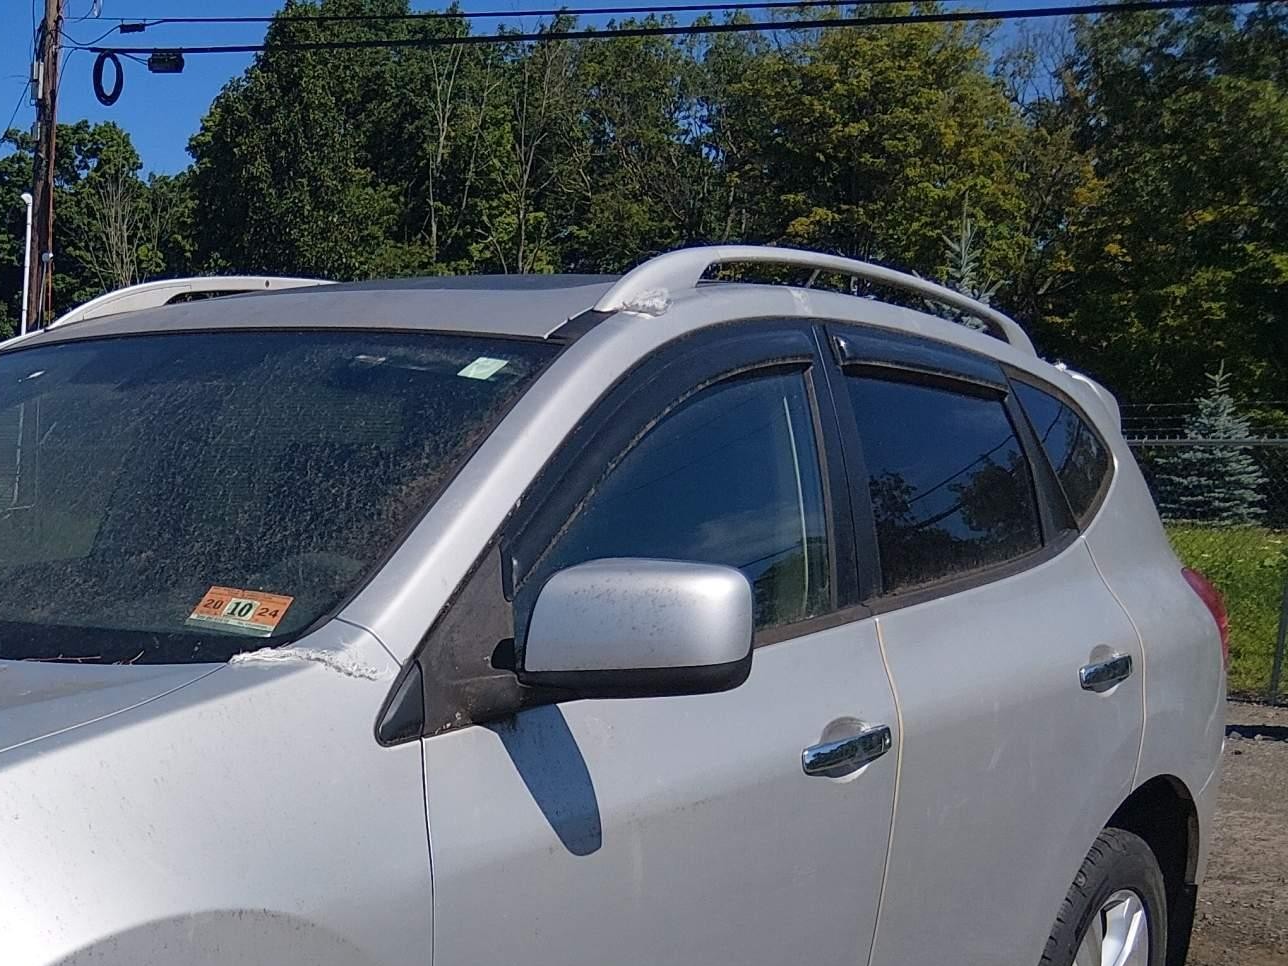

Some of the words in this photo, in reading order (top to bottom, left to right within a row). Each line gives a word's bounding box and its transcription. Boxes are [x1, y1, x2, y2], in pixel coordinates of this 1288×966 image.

[203, 599, 224, 609] 20
[227, 601, 253, 617] 10
[257, 607, 280, 618] 24
